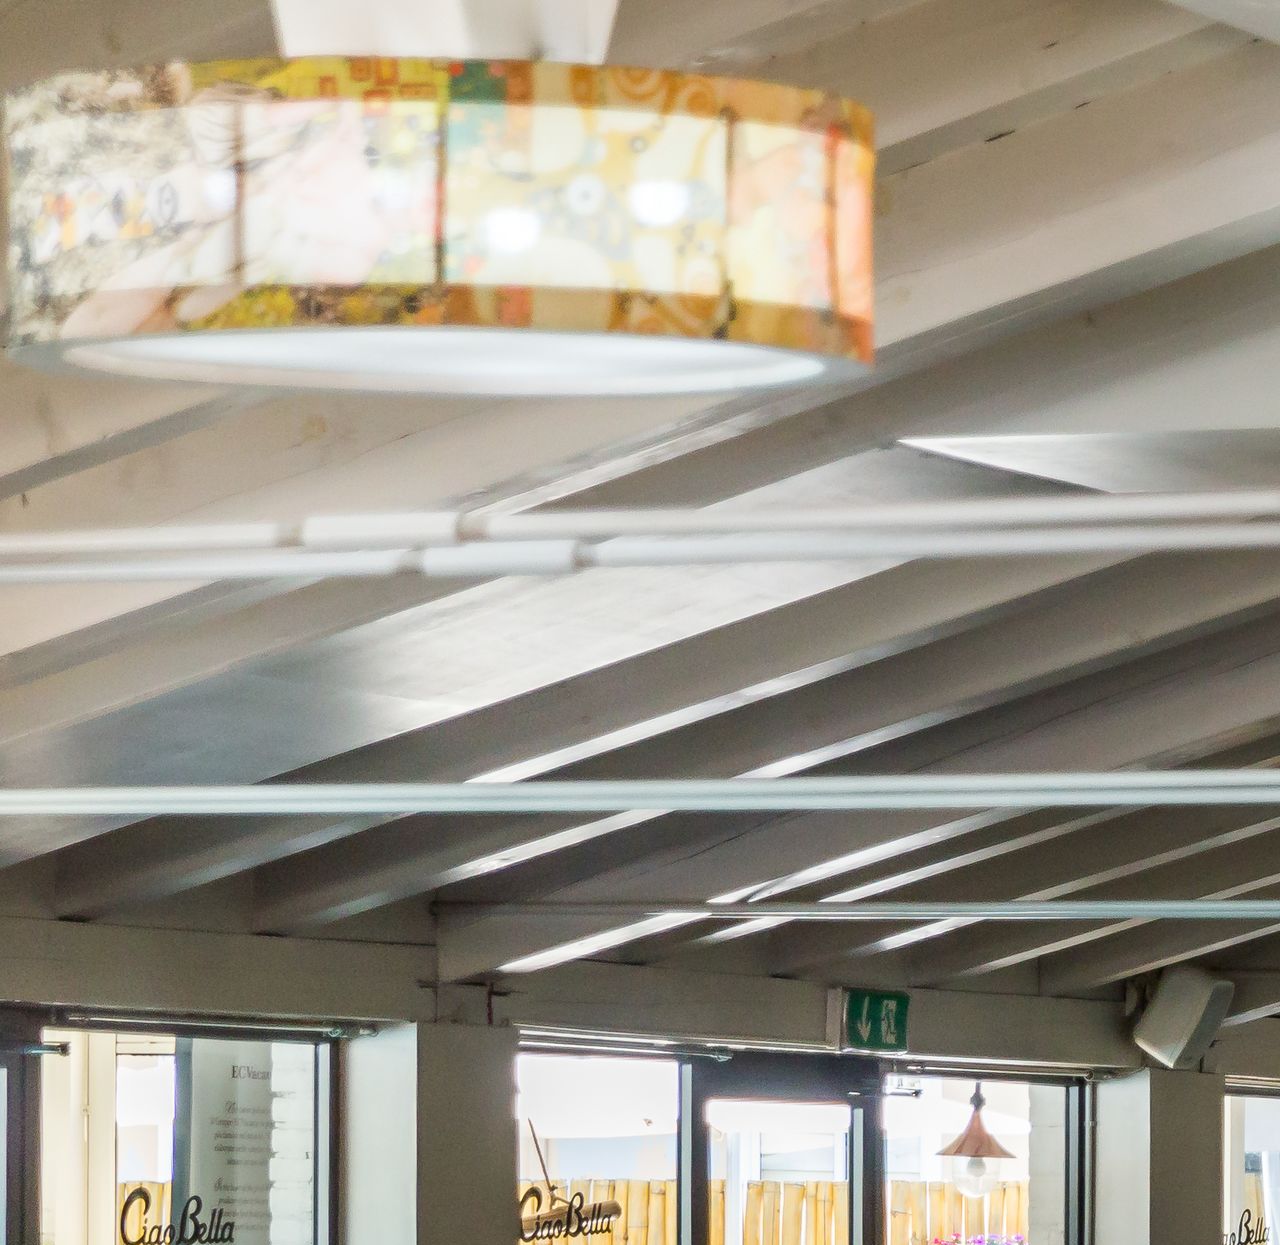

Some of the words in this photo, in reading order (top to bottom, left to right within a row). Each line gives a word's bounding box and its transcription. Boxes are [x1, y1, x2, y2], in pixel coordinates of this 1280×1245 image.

[175, 1195, 236, 1245] Bella
[519, 1186, 563, 1242] Ciao
[563, 1191, 613, 1238] Bella
